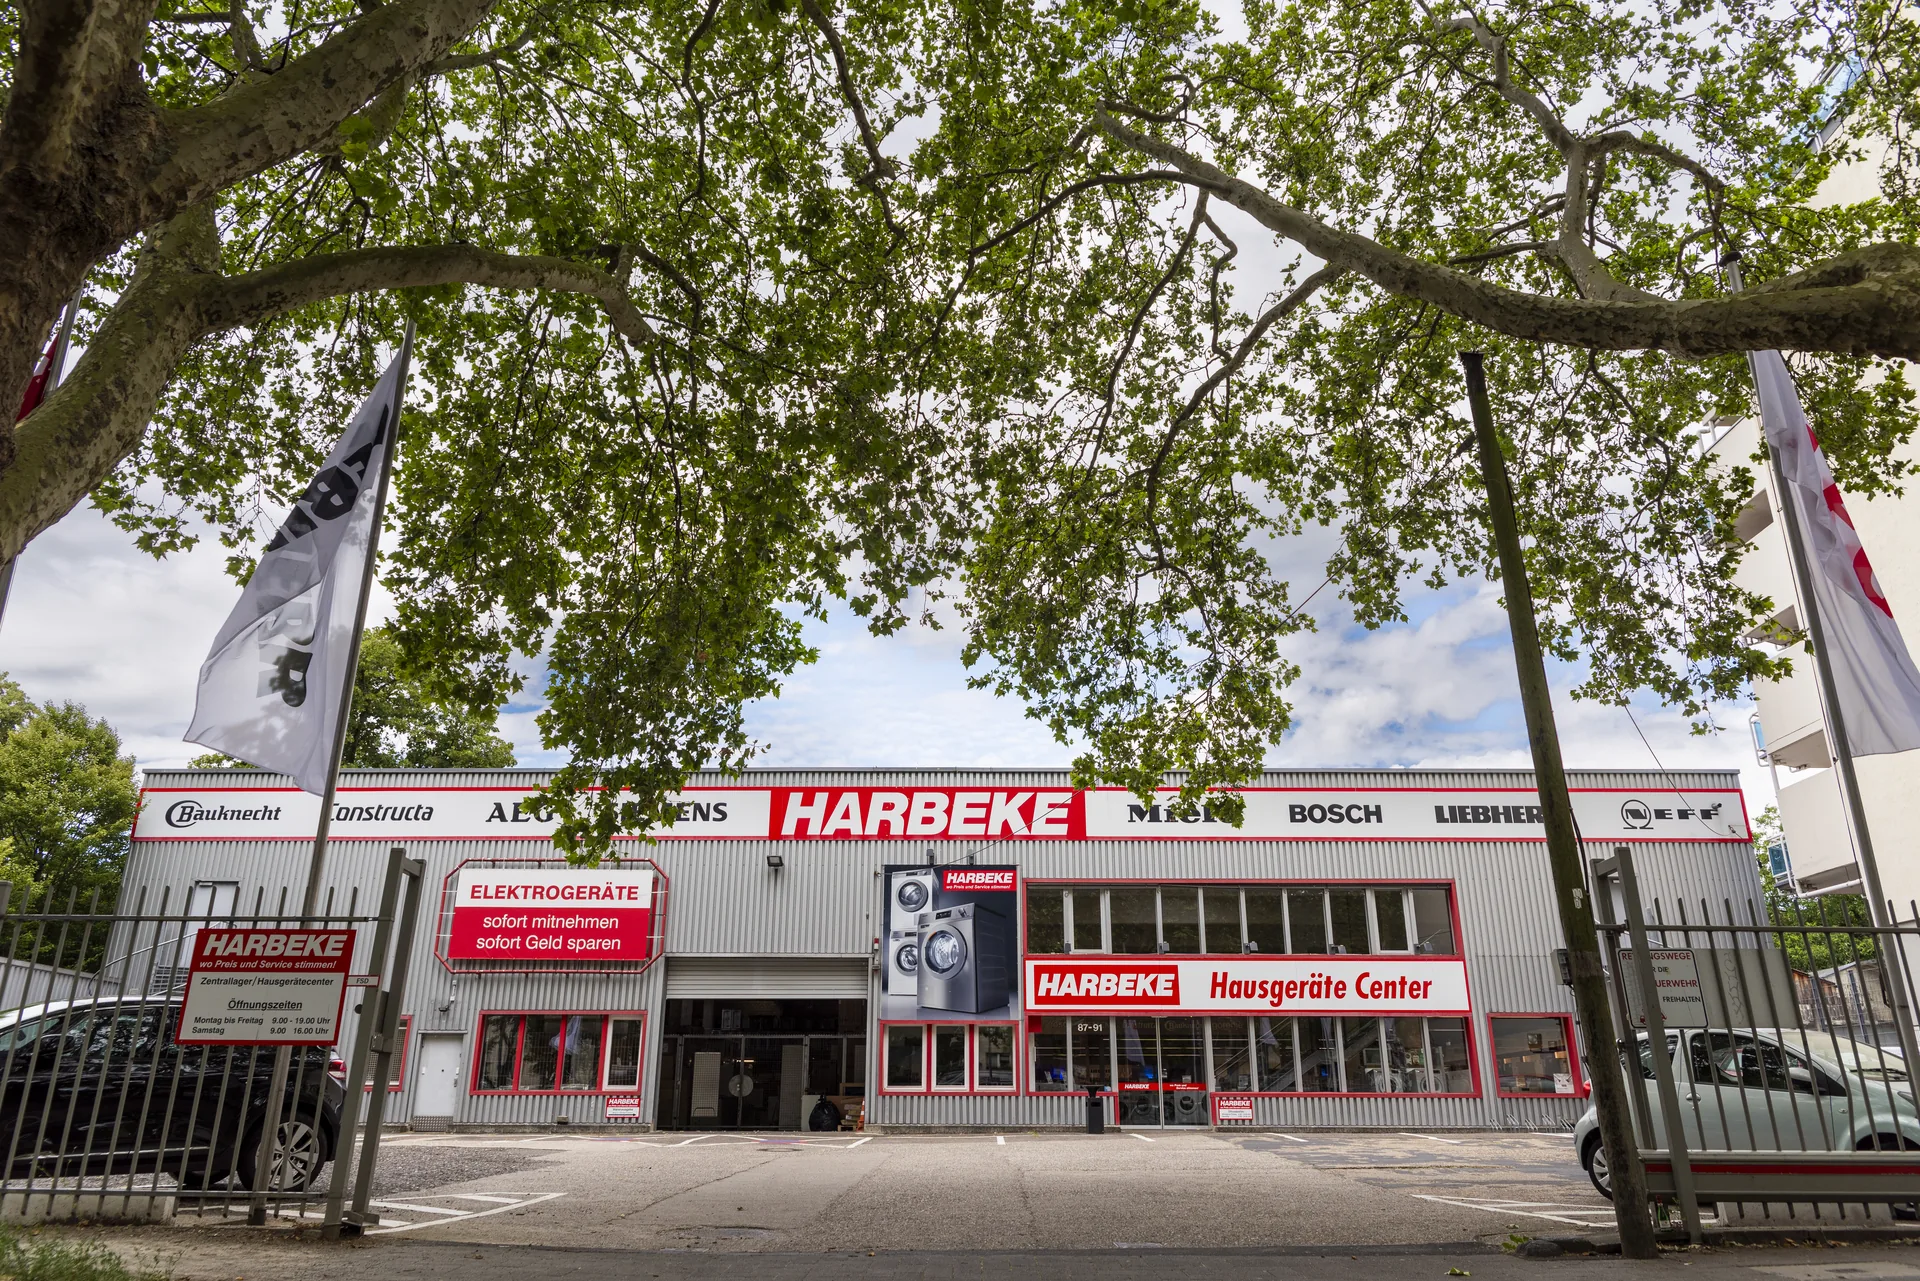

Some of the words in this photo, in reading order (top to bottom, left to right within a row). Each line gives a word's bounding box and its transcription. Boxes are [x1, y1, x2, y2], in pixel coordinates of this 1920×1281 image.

[166, 801, 282, 827] Bauknecht
[781, 792, 1073, 835] HARBEKE
[1288, 804, 1383, 823] BOSCH
[1434, 805, 1544, 824] LIEBHER
[947, 872, 1014, 883] HARBEKE
[470, 882, 639, 901] ELEKTROGERÄTE
[483, 914, 528, 929] sofort
[532, 915, 619, 929] mitnehmen
[202, 934, 348, 957] HARBEKE
[476, 935, 521, 949] sofort
[525, 936, 563, 950] Geld
[567, 939, 621, 953] sparen
[214, 960, 238, 968] Preis
[239, 960, 258, 968] und
[259, 960, 293, 969] Service
[294, 961, 337, 969] stimmen!
[1037, 973, 1175, 997] HARBEKE
[1210, 972, 1347, 1007] Hausgeräte
[1355, 972, 1432, 999] Center
[227, 998, 303, 1011] Öffnungszeiten
[193, 1016, 222, 1025] Montag
[237, 1017, 264, 1025] Freitag
[1077, 1023, 1103, 1032] 87-91
[192, 1026, 225, 1035] Samstag
